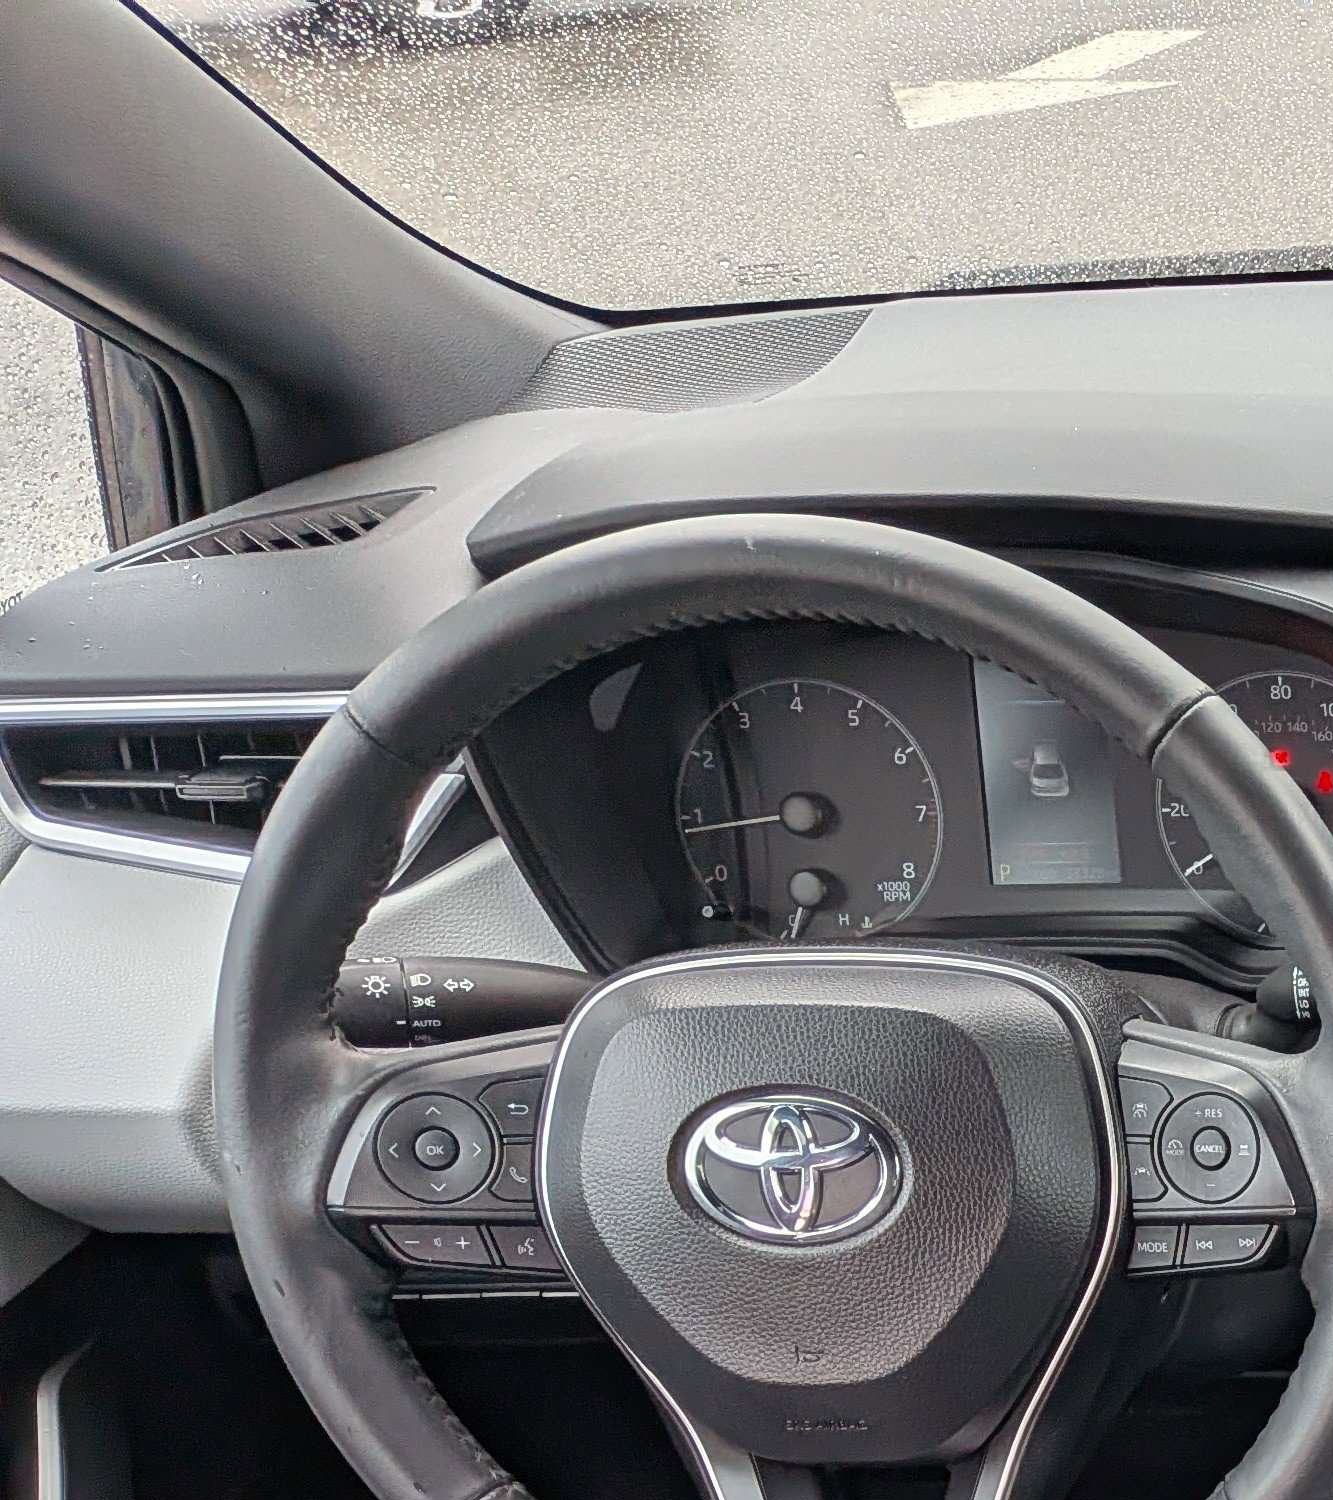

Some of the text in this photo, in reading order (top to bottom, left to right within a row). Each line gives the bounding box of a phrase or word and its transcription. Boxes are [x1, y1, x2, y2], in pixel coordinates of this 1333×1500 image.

[1270, 684, 1292, 700] 80
[790, 696, 803, 712] 4
[739, 712, 750, 729] 3
[848, 710, 860, 726] 5
[1260, 721, 1282, 733] 120
[1287, 721, 1308, 732] 140
[1312, 730, 1333, 741] 160
[703, 751, 716, 768] 2
[894, 748, 906, 765] 6
[694, 808, 702, 824] 1
[915, 805, 927, 823] 7
[715, 865, 728, 882] 0
[902, 862, 915, 879] 8
[1000, 863, 1010, 882] P
[877, 881, 910, 892] x1000
[884, 892, 911, 902] RPM
[838, 913, 850, 926] H
[412, 1020, 442, 1028] AUTO
[1204, 1108, 1222, 1118] RES
[426, 1146, 445, 1156] OK
[1196, 1145, 1224, 1154] CANCEL
[1137, 1242, 1169, 1253] MODE
